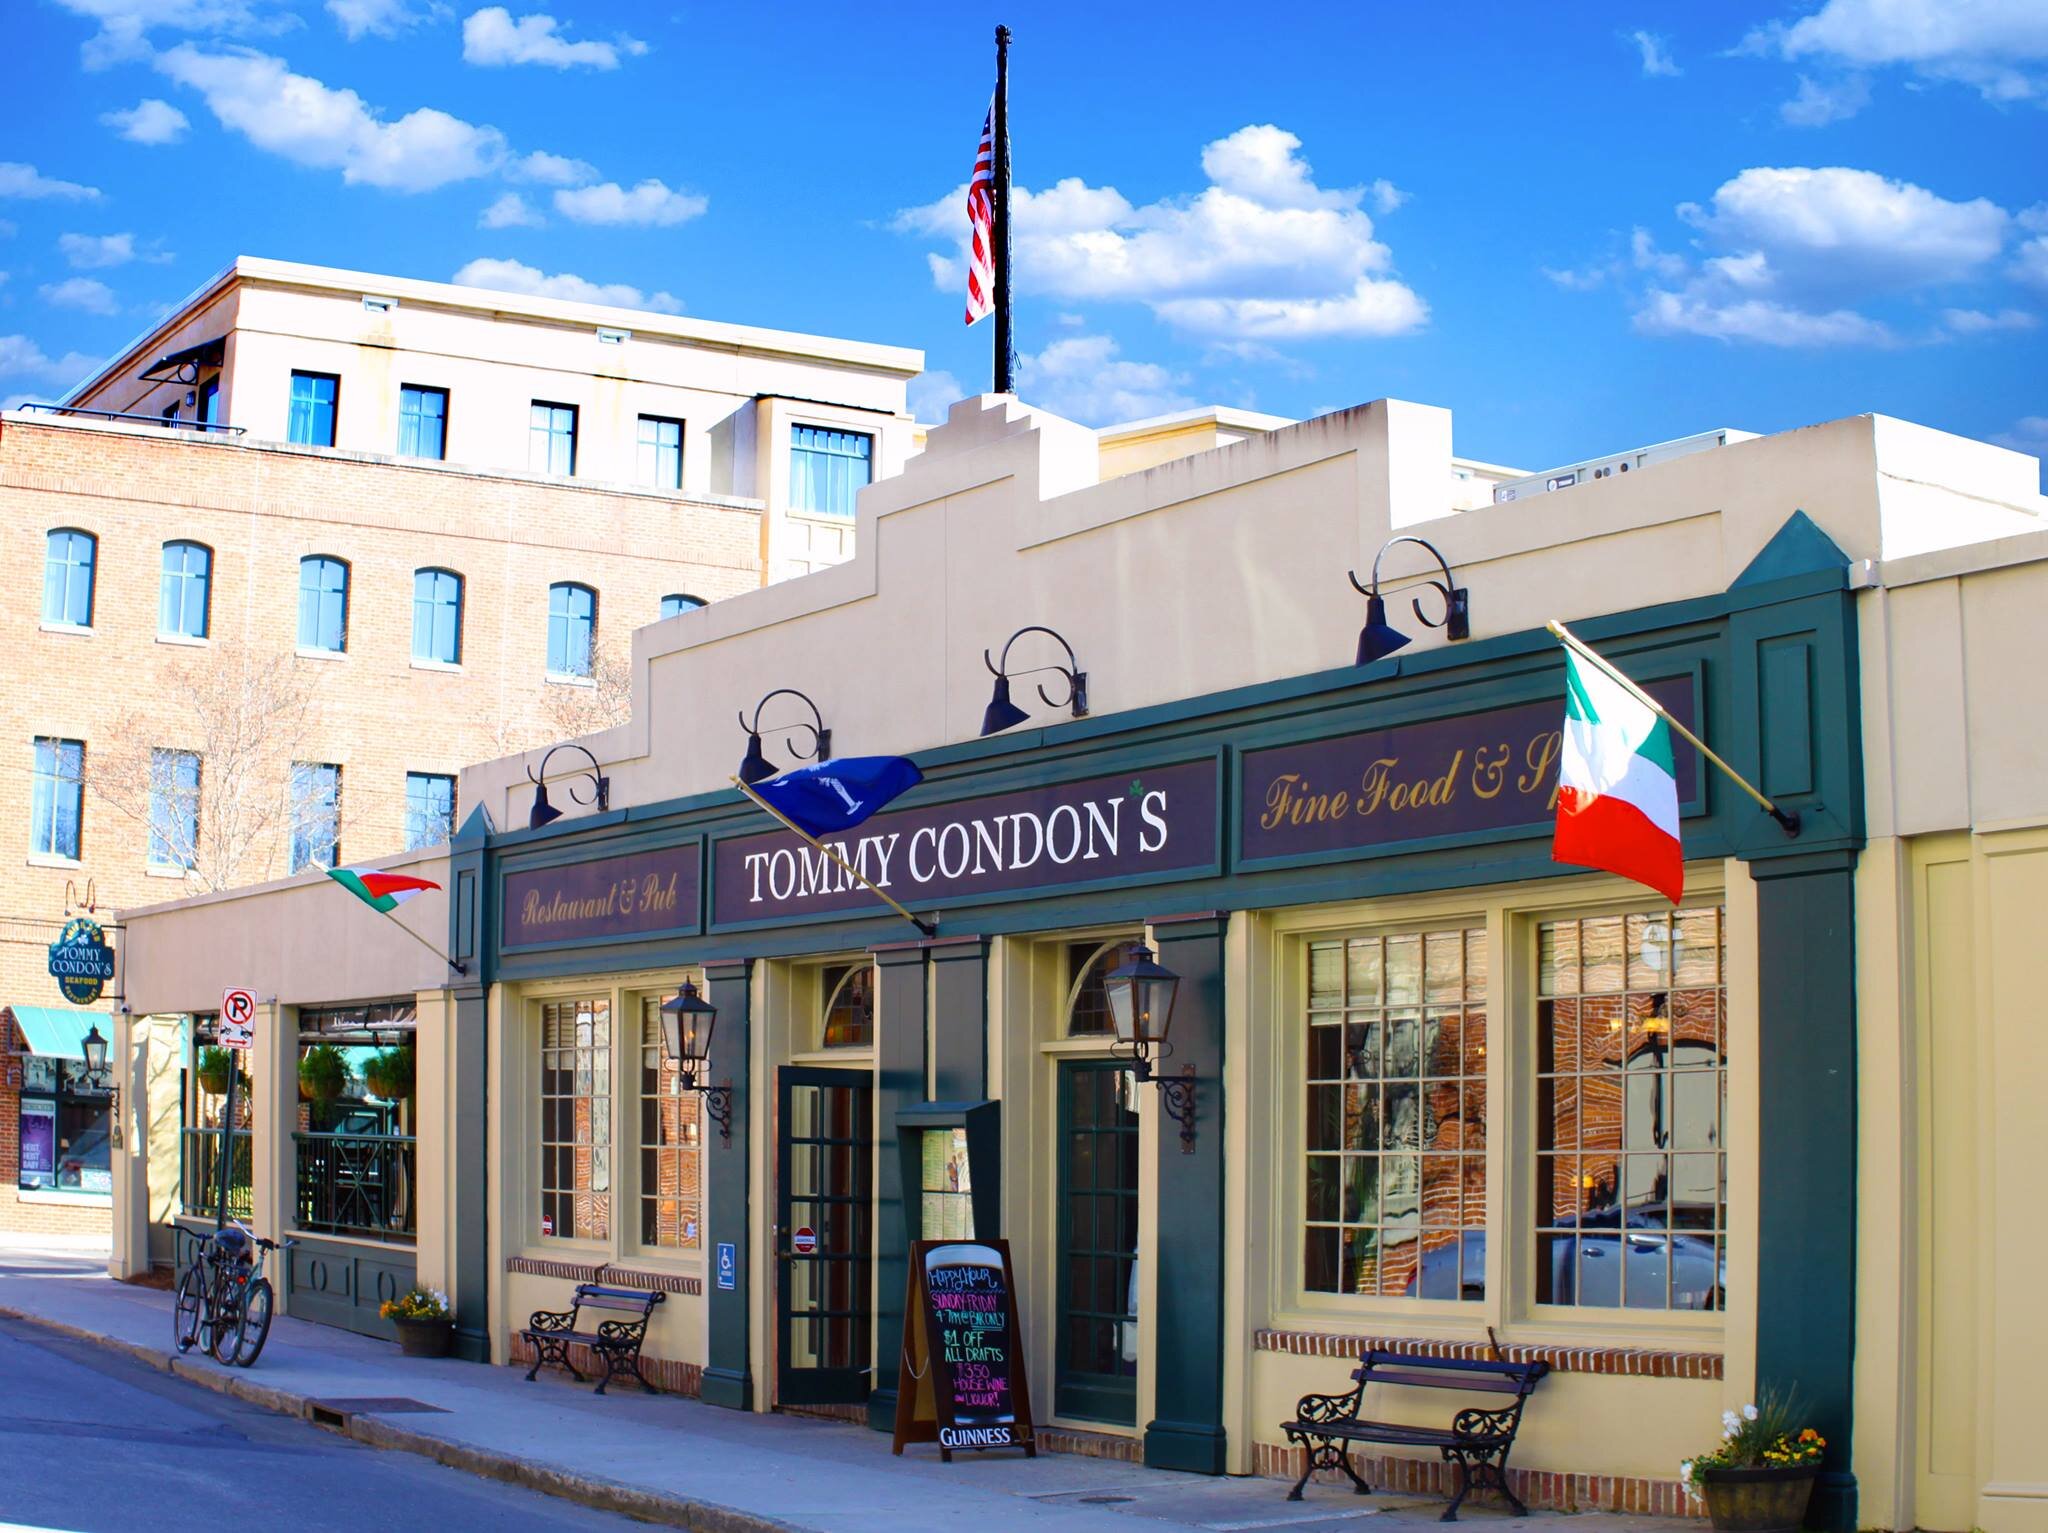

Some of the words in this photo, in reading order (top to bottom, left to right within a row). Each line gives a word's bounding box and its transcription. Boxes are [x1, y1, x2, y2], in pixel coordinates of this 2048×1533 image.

[1261, 774, 1348, 830] Fine
[1357, 750, 1463, 816] Food
[1472, 744, 1510, 799] &
[745, 832, 899, 902] TOMMY
[521, 883, 617, 926] Restaurant
[619, 878, 636, 914] &
[639, 872, 678, 912] Pub
[61, 946, 101, 961] TOMMY
[52, 960, 112, 976] CONDON'S
[65, 976, 98, 985] SEAFOOD
[943, 1329, 960, 1347] $1
[963, 1331, 985, 1348] OFF
[944, 1346, 964, 1362] ALL
[965, 1347, 1004, 1362] DRAFTS
[940, 1427, 1011, 1446] GUINNESS
